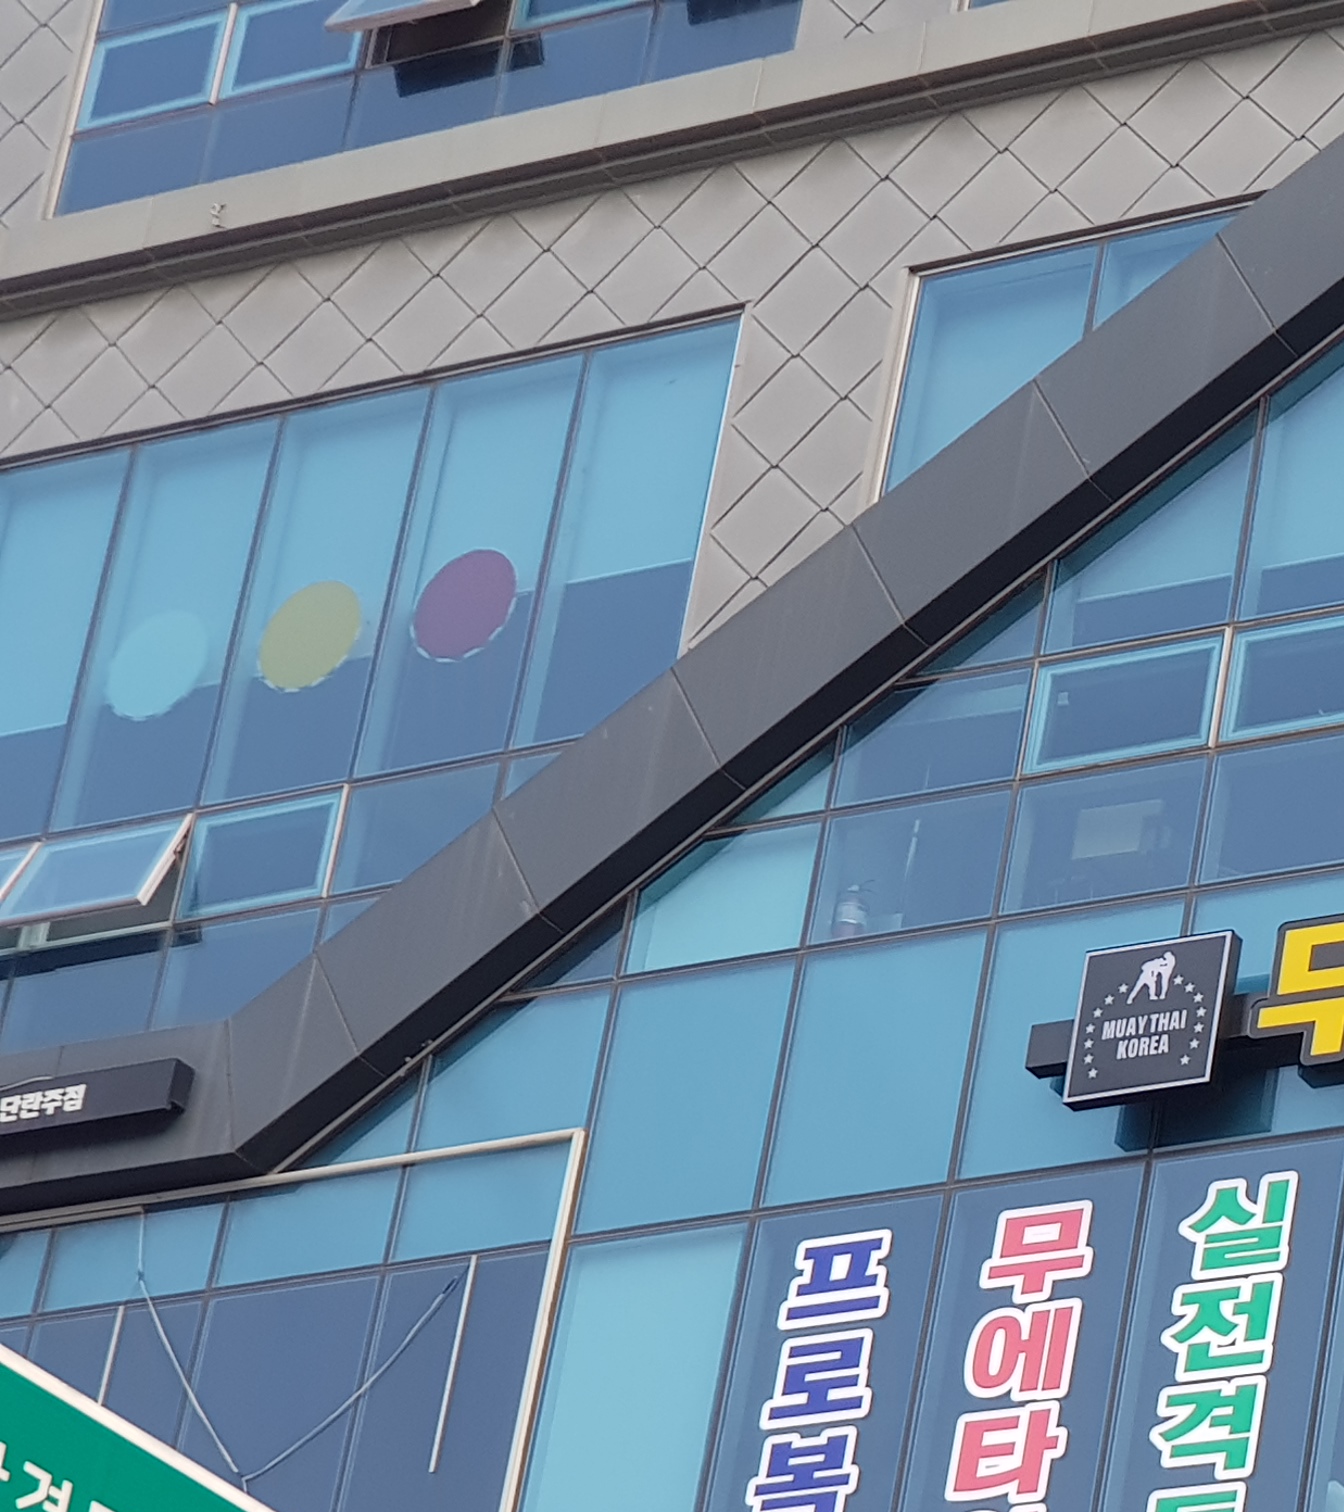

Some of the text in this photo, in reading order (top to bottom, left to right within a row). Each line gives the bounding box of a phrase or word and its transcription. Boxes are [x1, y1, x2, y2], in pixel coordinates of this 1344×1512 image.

[1102, 1009, 1187, 1040] MUAY THAI
[1117, 1034, 1169, 1060] KOREA
[0, 1084, 87, 1123] 단란주점
